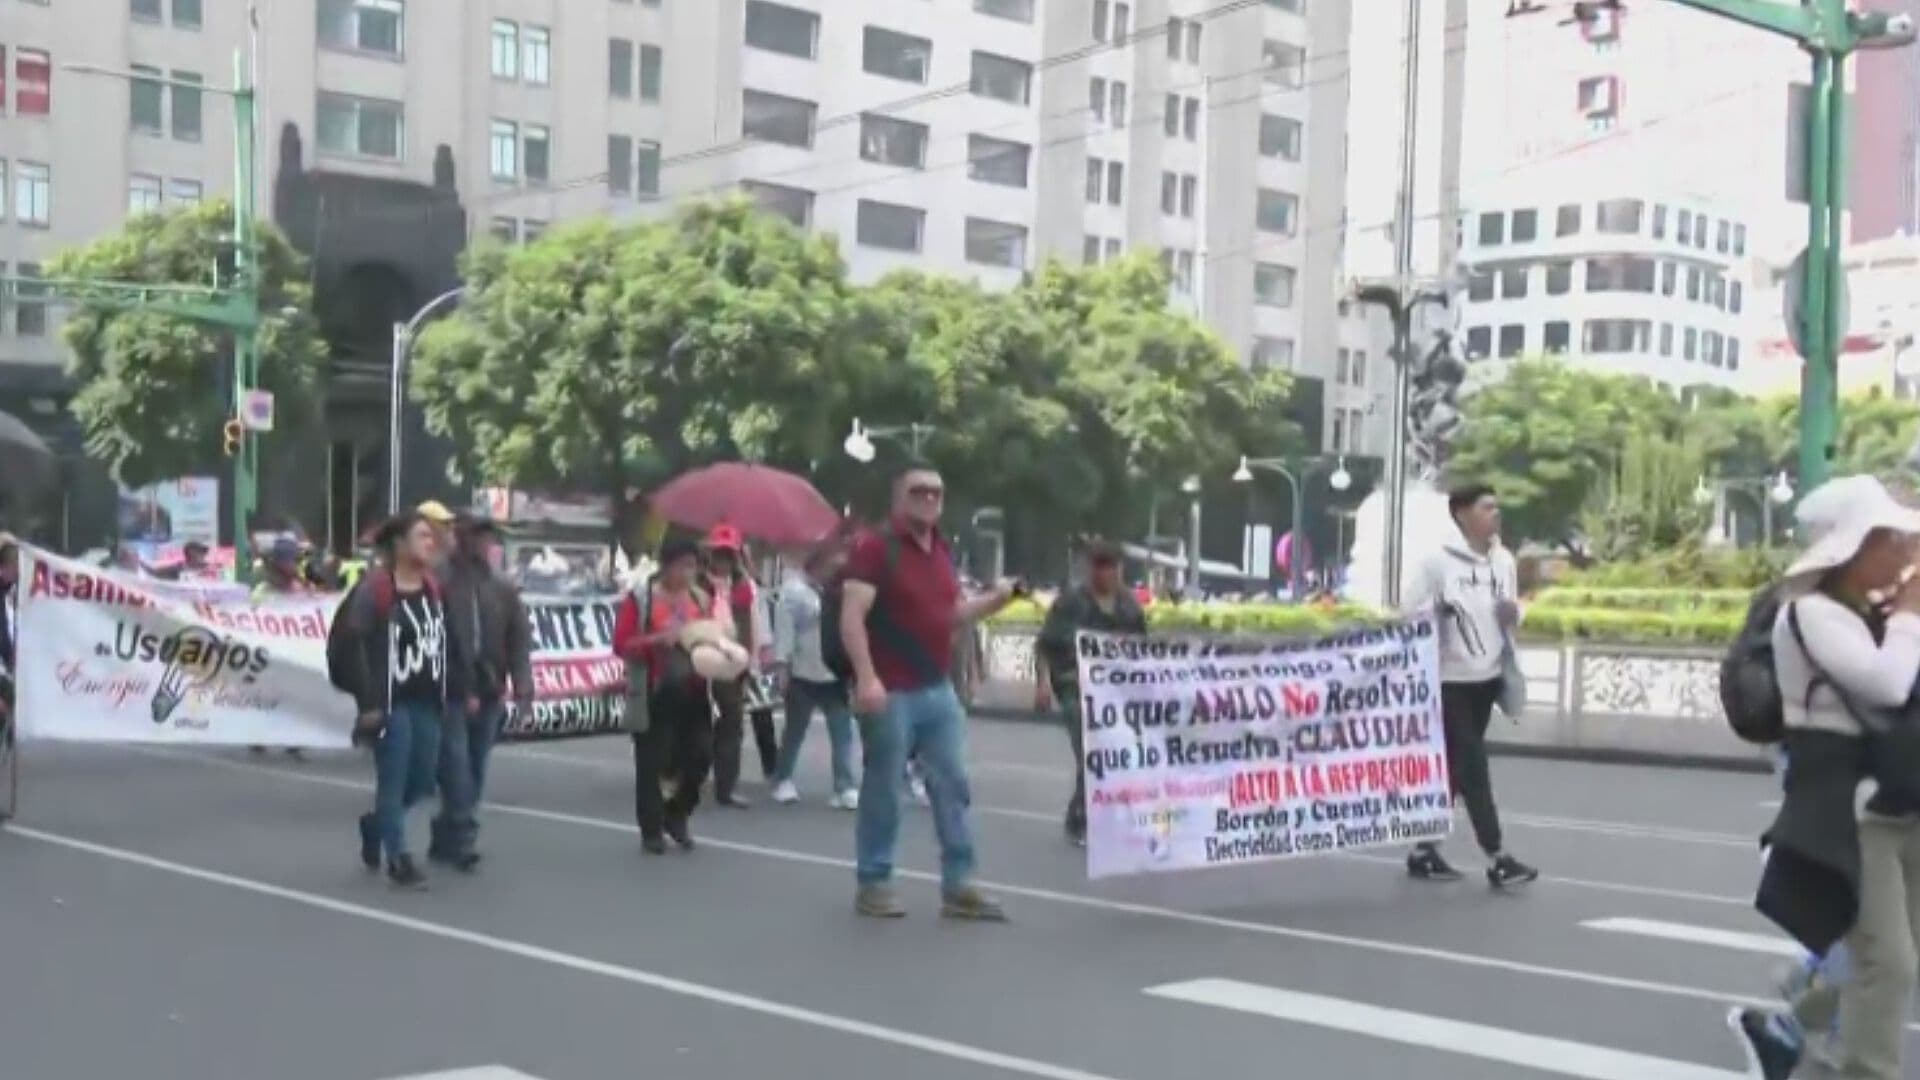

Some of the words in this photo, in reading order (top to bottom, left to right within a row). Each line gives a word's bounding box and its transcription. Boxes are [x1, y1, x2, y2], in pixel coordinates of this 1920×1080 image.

[114, 621, 270, 673] Usuarios
[1085, 695, 1118, 730] Lo
[1124, 700, 1181, 736] que
[1189, 684, 1276, 727] AMLO
[1281, 682, 1320, 720] No
[1086, 749, 1132, 780] que
[1137, 742, 1161, 769] lo
[1165, 732, 1280, 767] Resuelva
[1286, 711, 1430, 763] ¡CLAUDIA!
[1284, 765, 1299, 798] A
[1301, 763, 1326, 797] LA
[1294, 807, 1306, 828] y
[1310, 796, 1382, 823] Cuenta
[1386, 790, 1448, 815] Nueva
